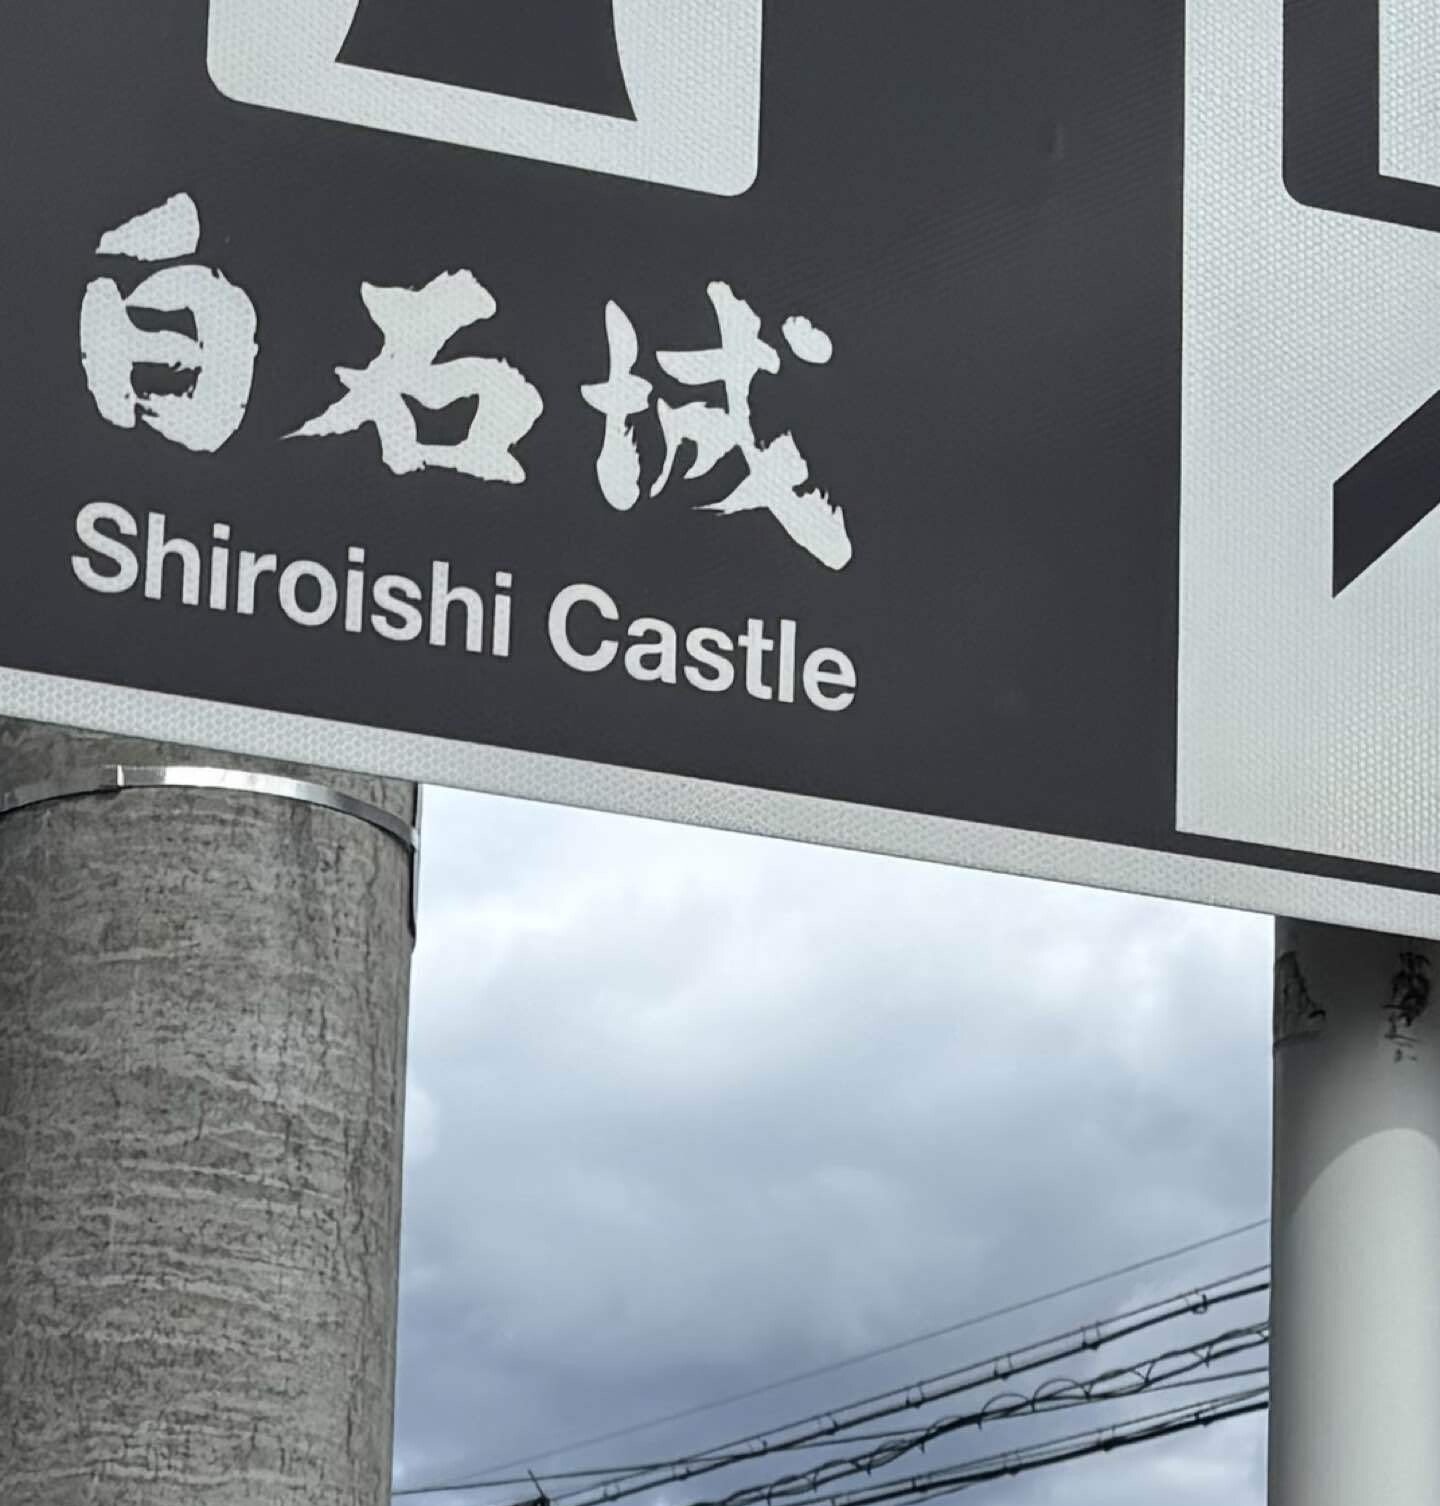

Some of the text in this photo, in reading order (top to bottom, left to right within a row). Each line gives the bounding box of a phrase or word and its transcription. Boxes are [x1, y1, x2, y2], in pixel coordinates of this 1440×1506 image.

[80, 192, 852, 571] 白石城
[71, 502, 857, 711] Shiroishi Castle
